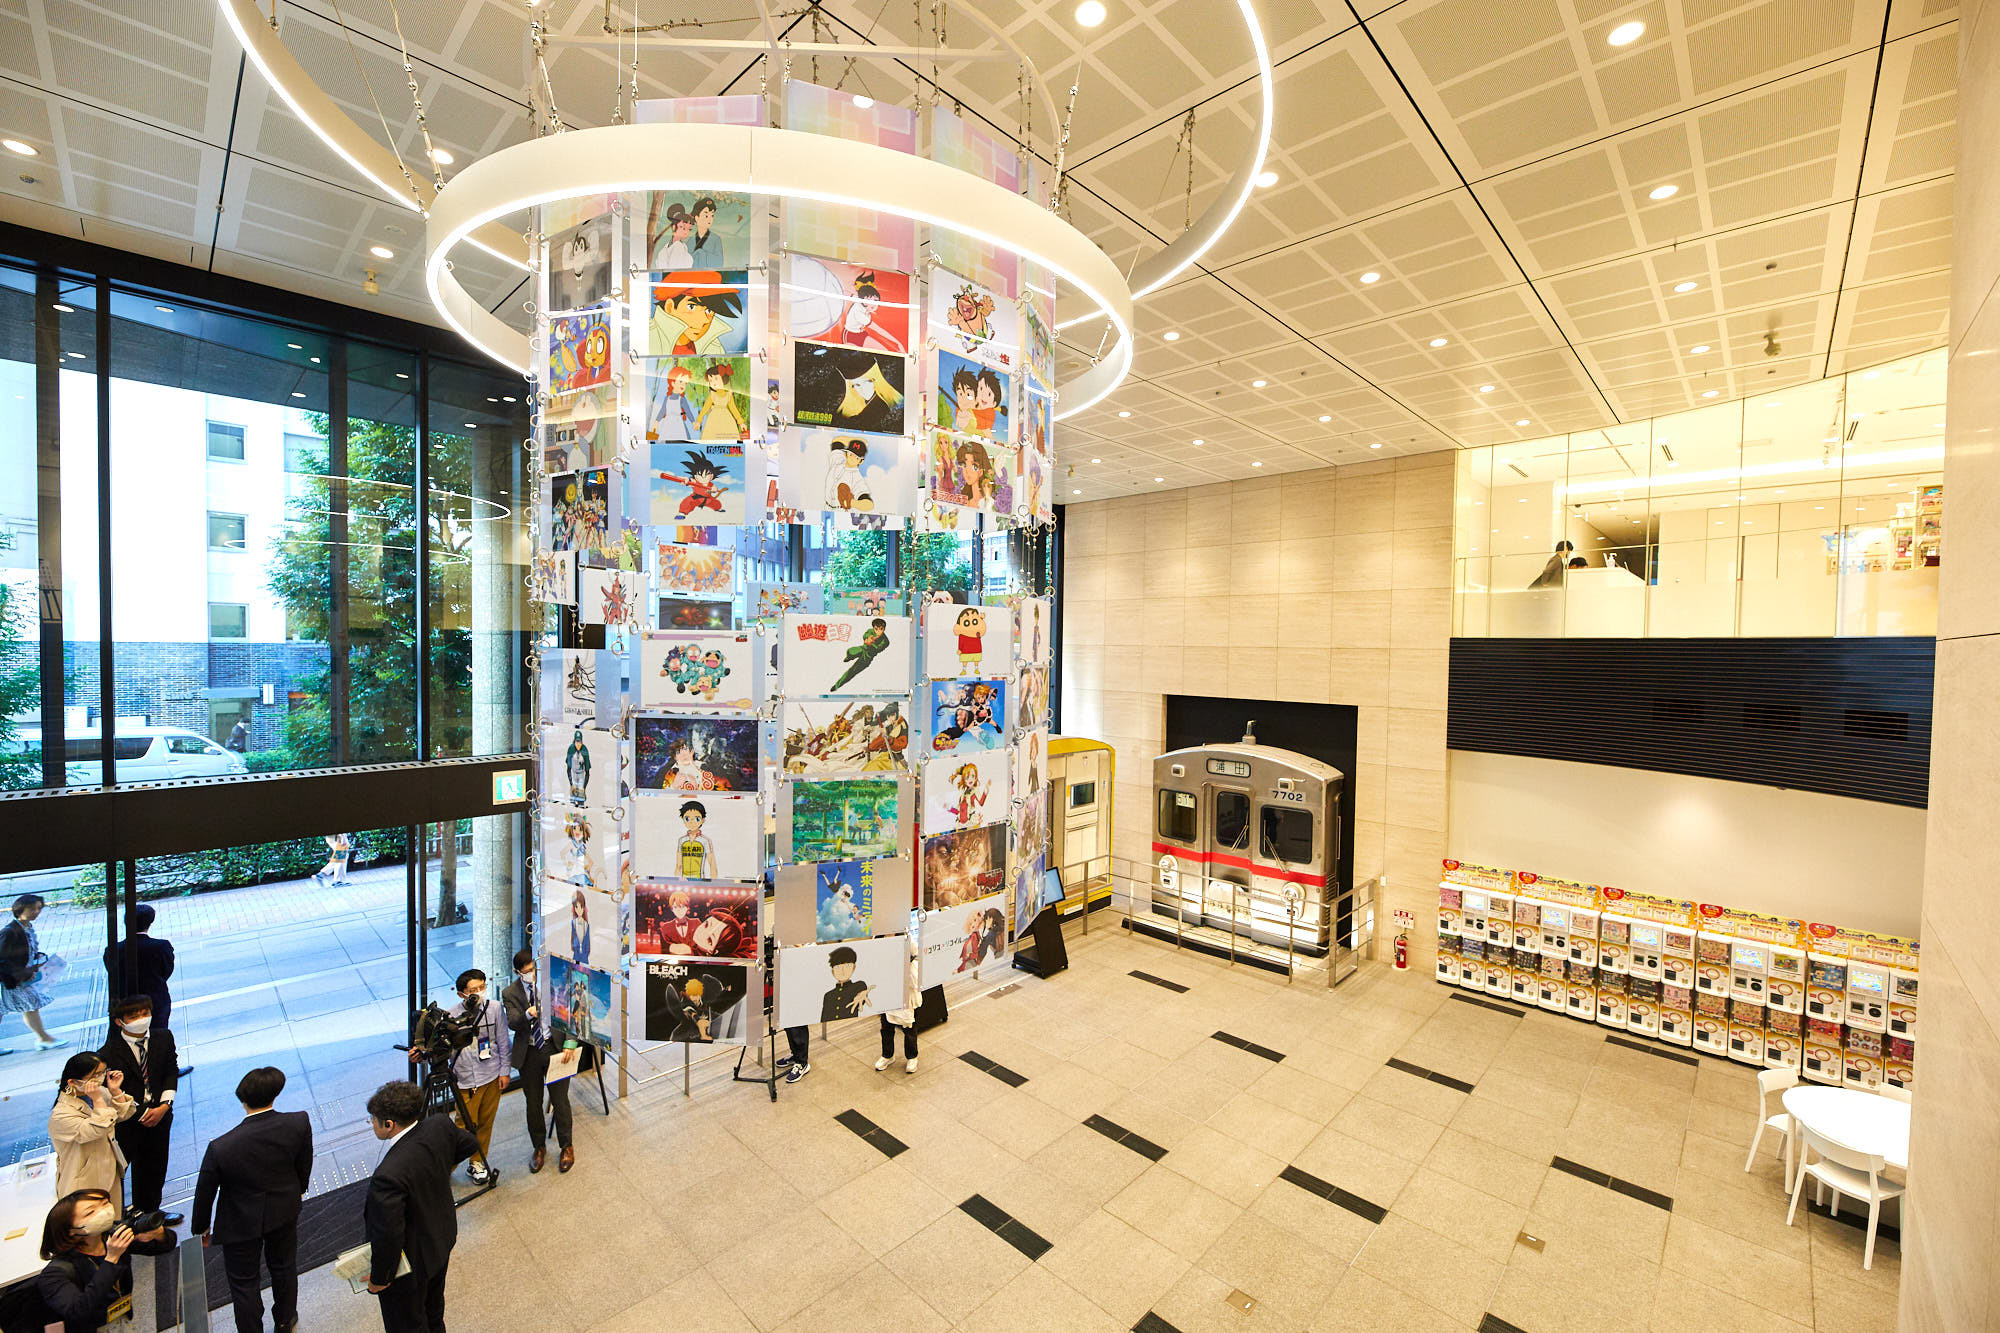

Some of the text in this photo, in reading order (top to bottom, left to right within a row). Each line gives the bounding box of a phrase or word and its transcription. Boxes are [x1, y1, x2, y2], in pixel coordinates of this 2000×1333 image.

[1272, 790, 1303, 802] 7702
[860, 860, 873, 936] 未来のミライ
[648, 964, 689, 977] BLEACH
